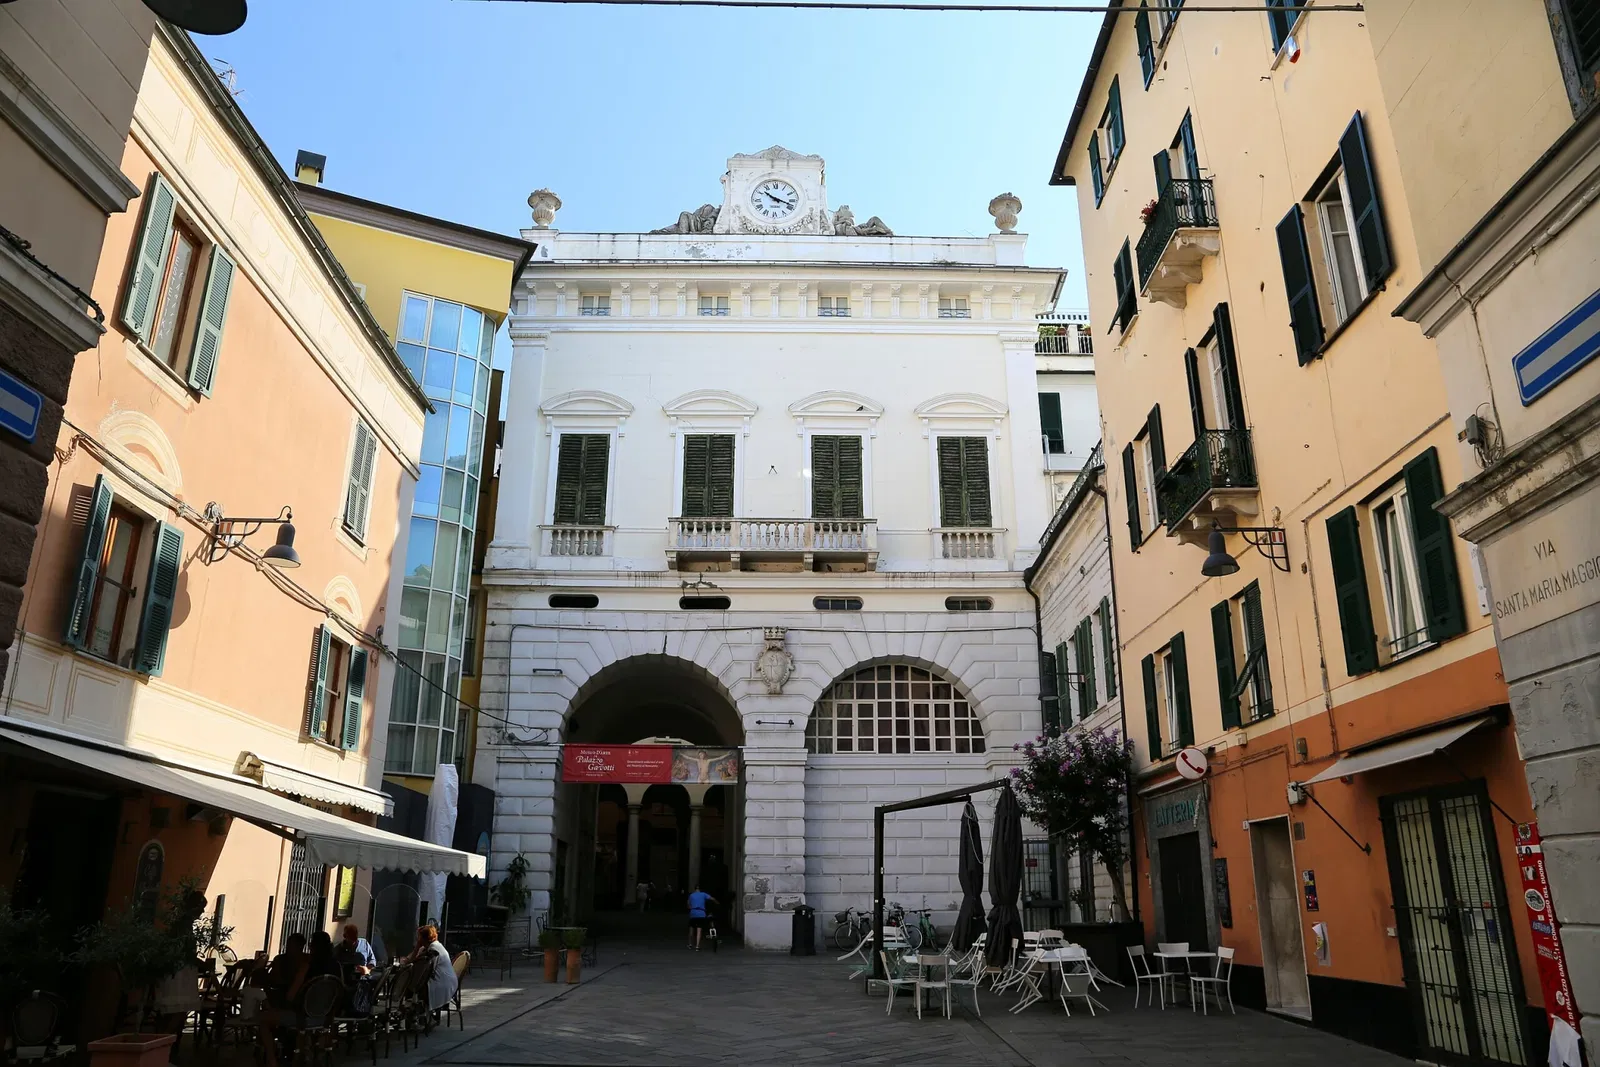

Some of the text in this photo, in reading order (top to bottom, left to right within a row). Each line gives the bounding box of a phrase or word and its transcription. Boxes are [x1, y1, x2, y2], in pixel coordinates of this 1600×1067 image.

[158, 256, 180, 339] ESTETIKA
[1534, 539, 1556, 560] VIA
[1495, 589, 1530, 619] SANTA
[1528, 577, 1562, 607] MARIA
[575, 755, 604, 765] Palazzo
[588, 763, 615, 771] Gavotti
[1155, 799, 1196, 828] LATTERIA
[1537, 859, 1548, 885] DUOMO
[1541, 885, 1549, 899] DEL
[1545, 899, 1558, 941] COMPLESSO
[1561, 978, 1573, 1010] PALAZZO
